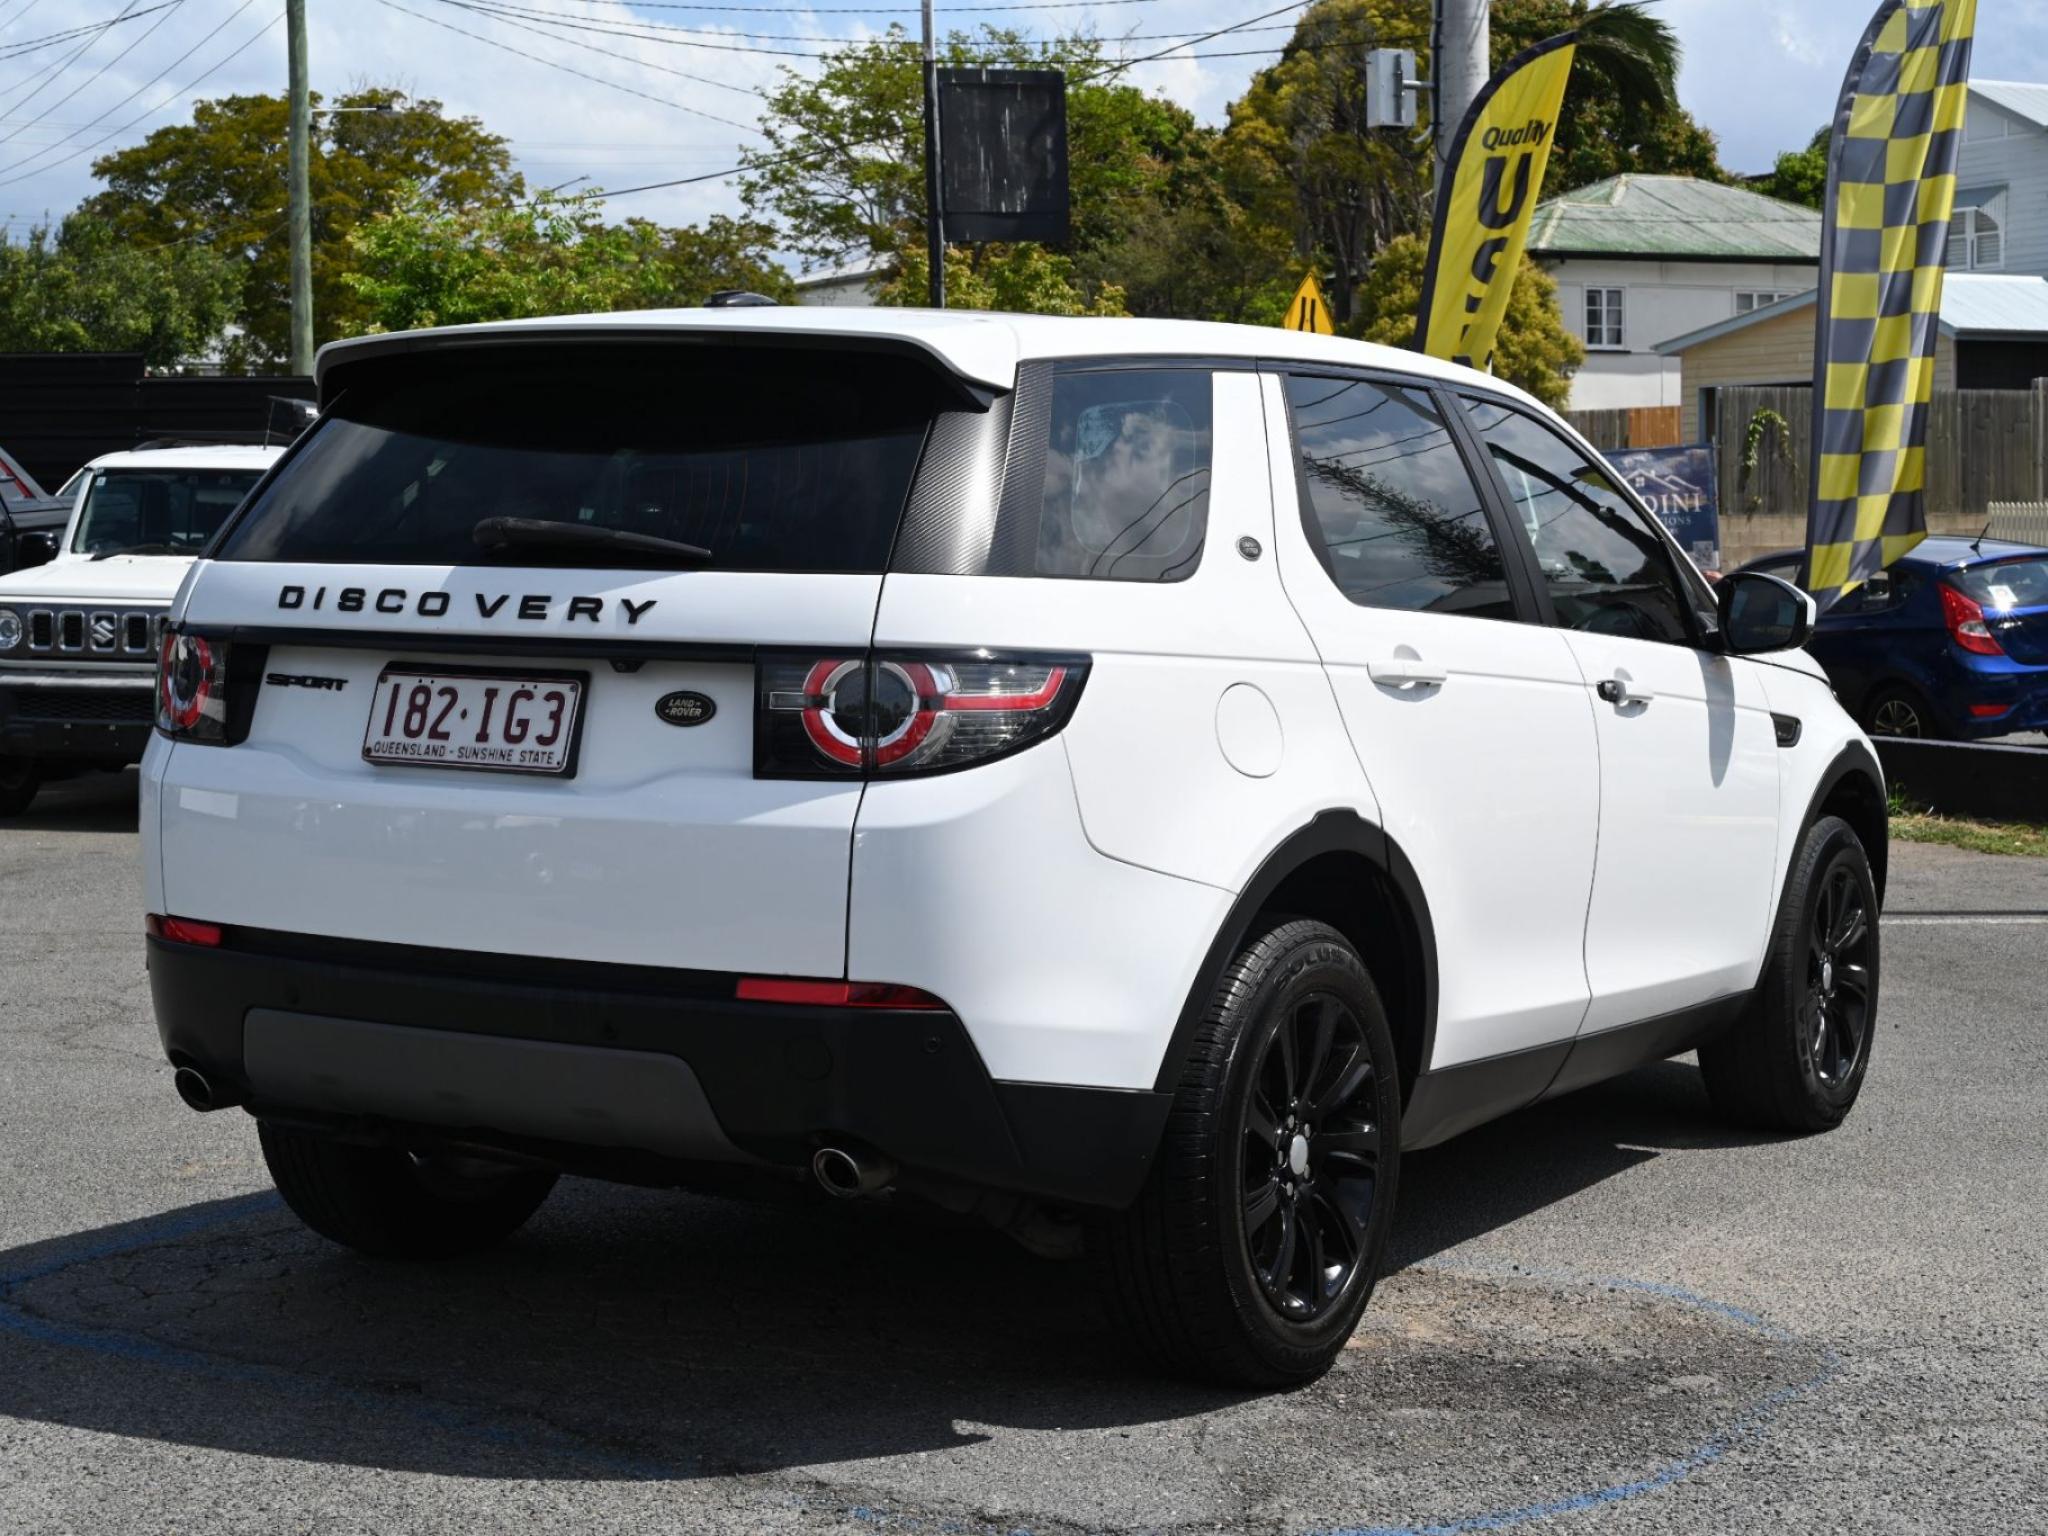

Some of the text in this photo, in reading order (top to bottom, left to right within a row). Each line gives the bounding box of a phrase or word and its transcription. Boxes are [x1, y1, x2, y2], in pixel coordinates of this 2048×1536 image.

[1482, 119, 1552, 151] Quality
[278, 585, 658, 624] DISCOVERY
[266, 673, 348, 691] SPORT
[670, 707, 702, 717] ROVER
[373, 741, 555, 765] QUEENSLAND SUNSHINE STATE
